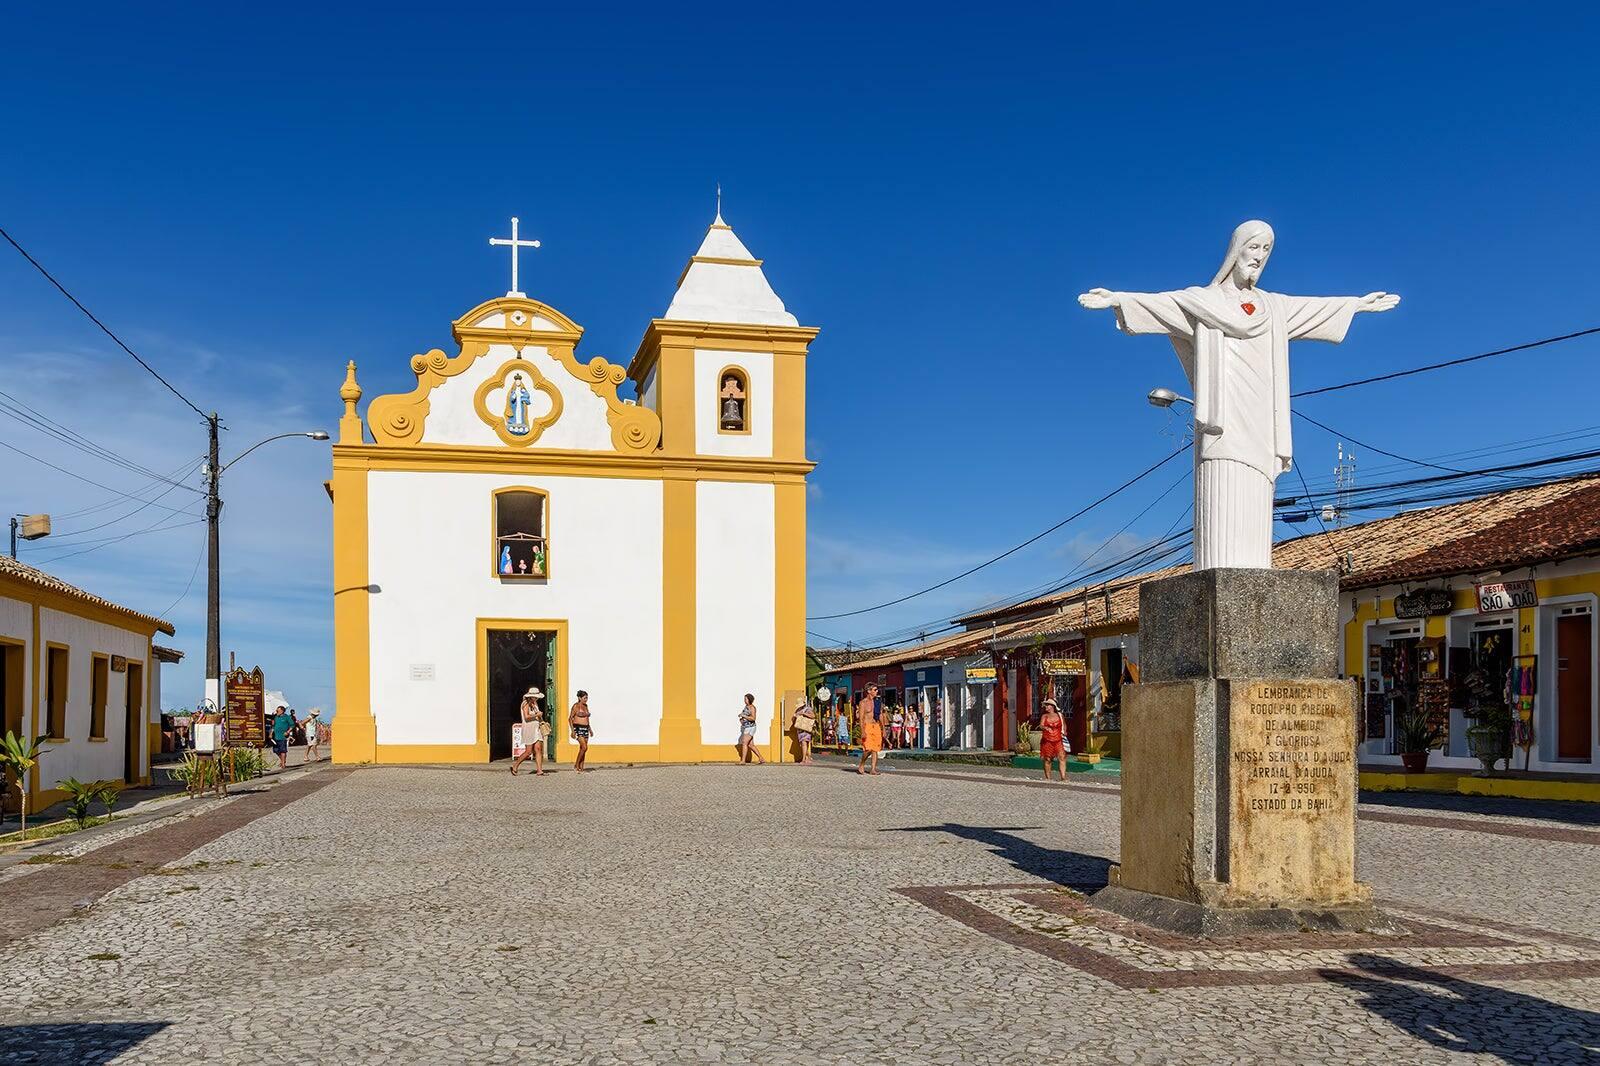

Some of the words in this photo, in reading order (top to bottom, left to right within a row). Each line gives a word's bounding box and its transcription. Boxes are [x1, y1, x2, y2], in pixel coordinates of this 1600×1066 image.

[1483, 581, 1530, 594] RESTAURANTE
[1318, 688, 1328, 699] DE
[1250, 703, 1297, 715] RODOLPHO
[1301, 703, 1336, 716] RIBEIRO
[1265, 719, 1276, 731] DE
[1281, 719, 1321, 731] ALMEIDA
[1275, 735, 1321, 746] GLORIOSA
[1234, 751, 1263, 762] NOSSA
[1268, 751, 1309, 762] SENHORA
[1253, 767, 1290, 778] ARRAIAL
[1251, 798, 1287, 810] ESTADO
[1291, 798, 1302, 810] DA
[1307, 798, 1333, 810] BAHIA
